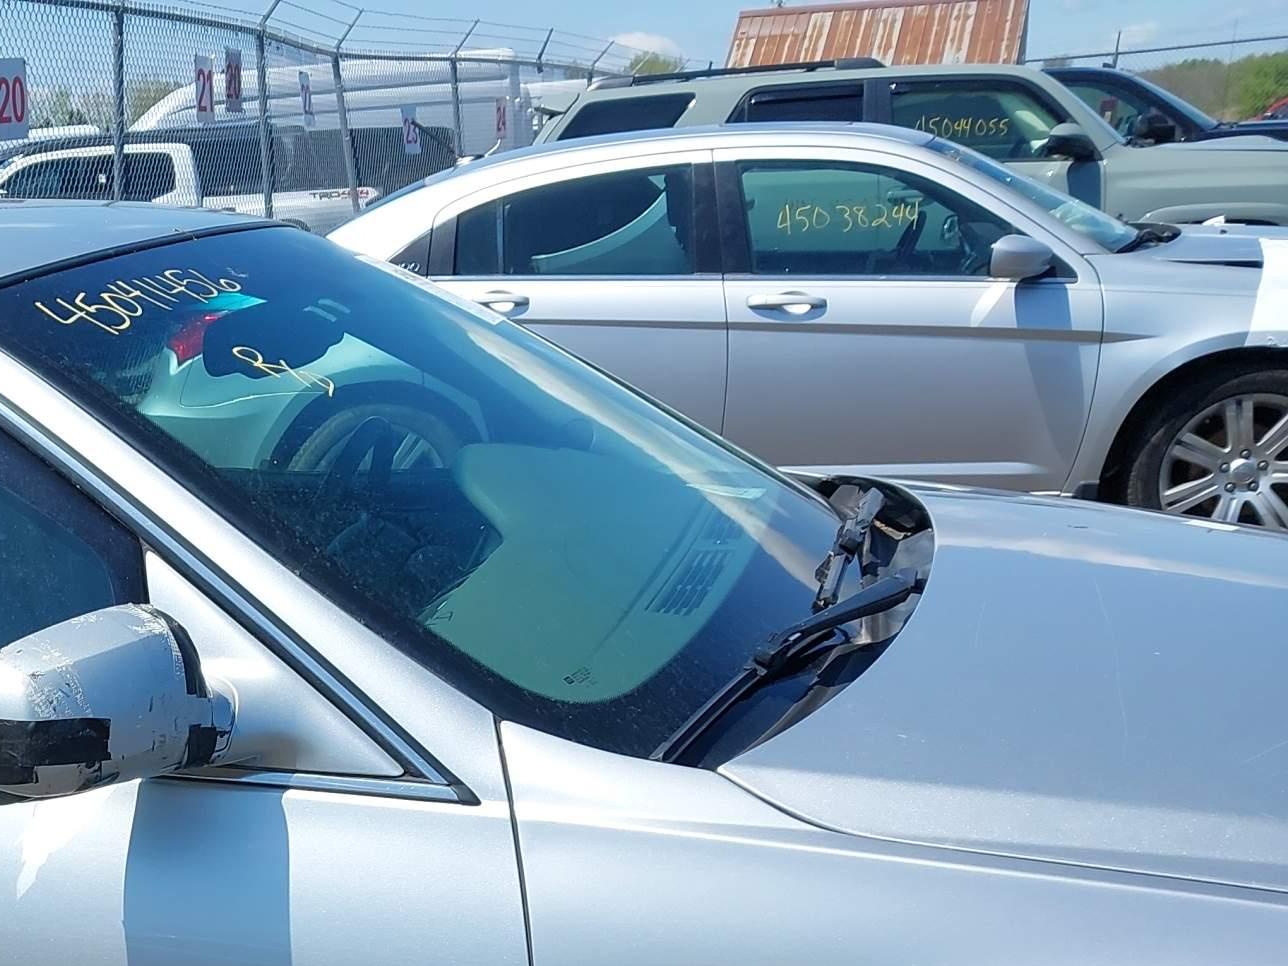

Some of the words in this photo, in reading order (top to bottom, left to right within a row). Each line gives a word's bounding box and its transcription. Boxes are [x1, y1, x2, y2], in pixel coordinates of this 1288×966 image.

[197, 68, 214, 112] 21
[496, 105, 506, 131] 24
[34, 268, 242, 336] 45041456
